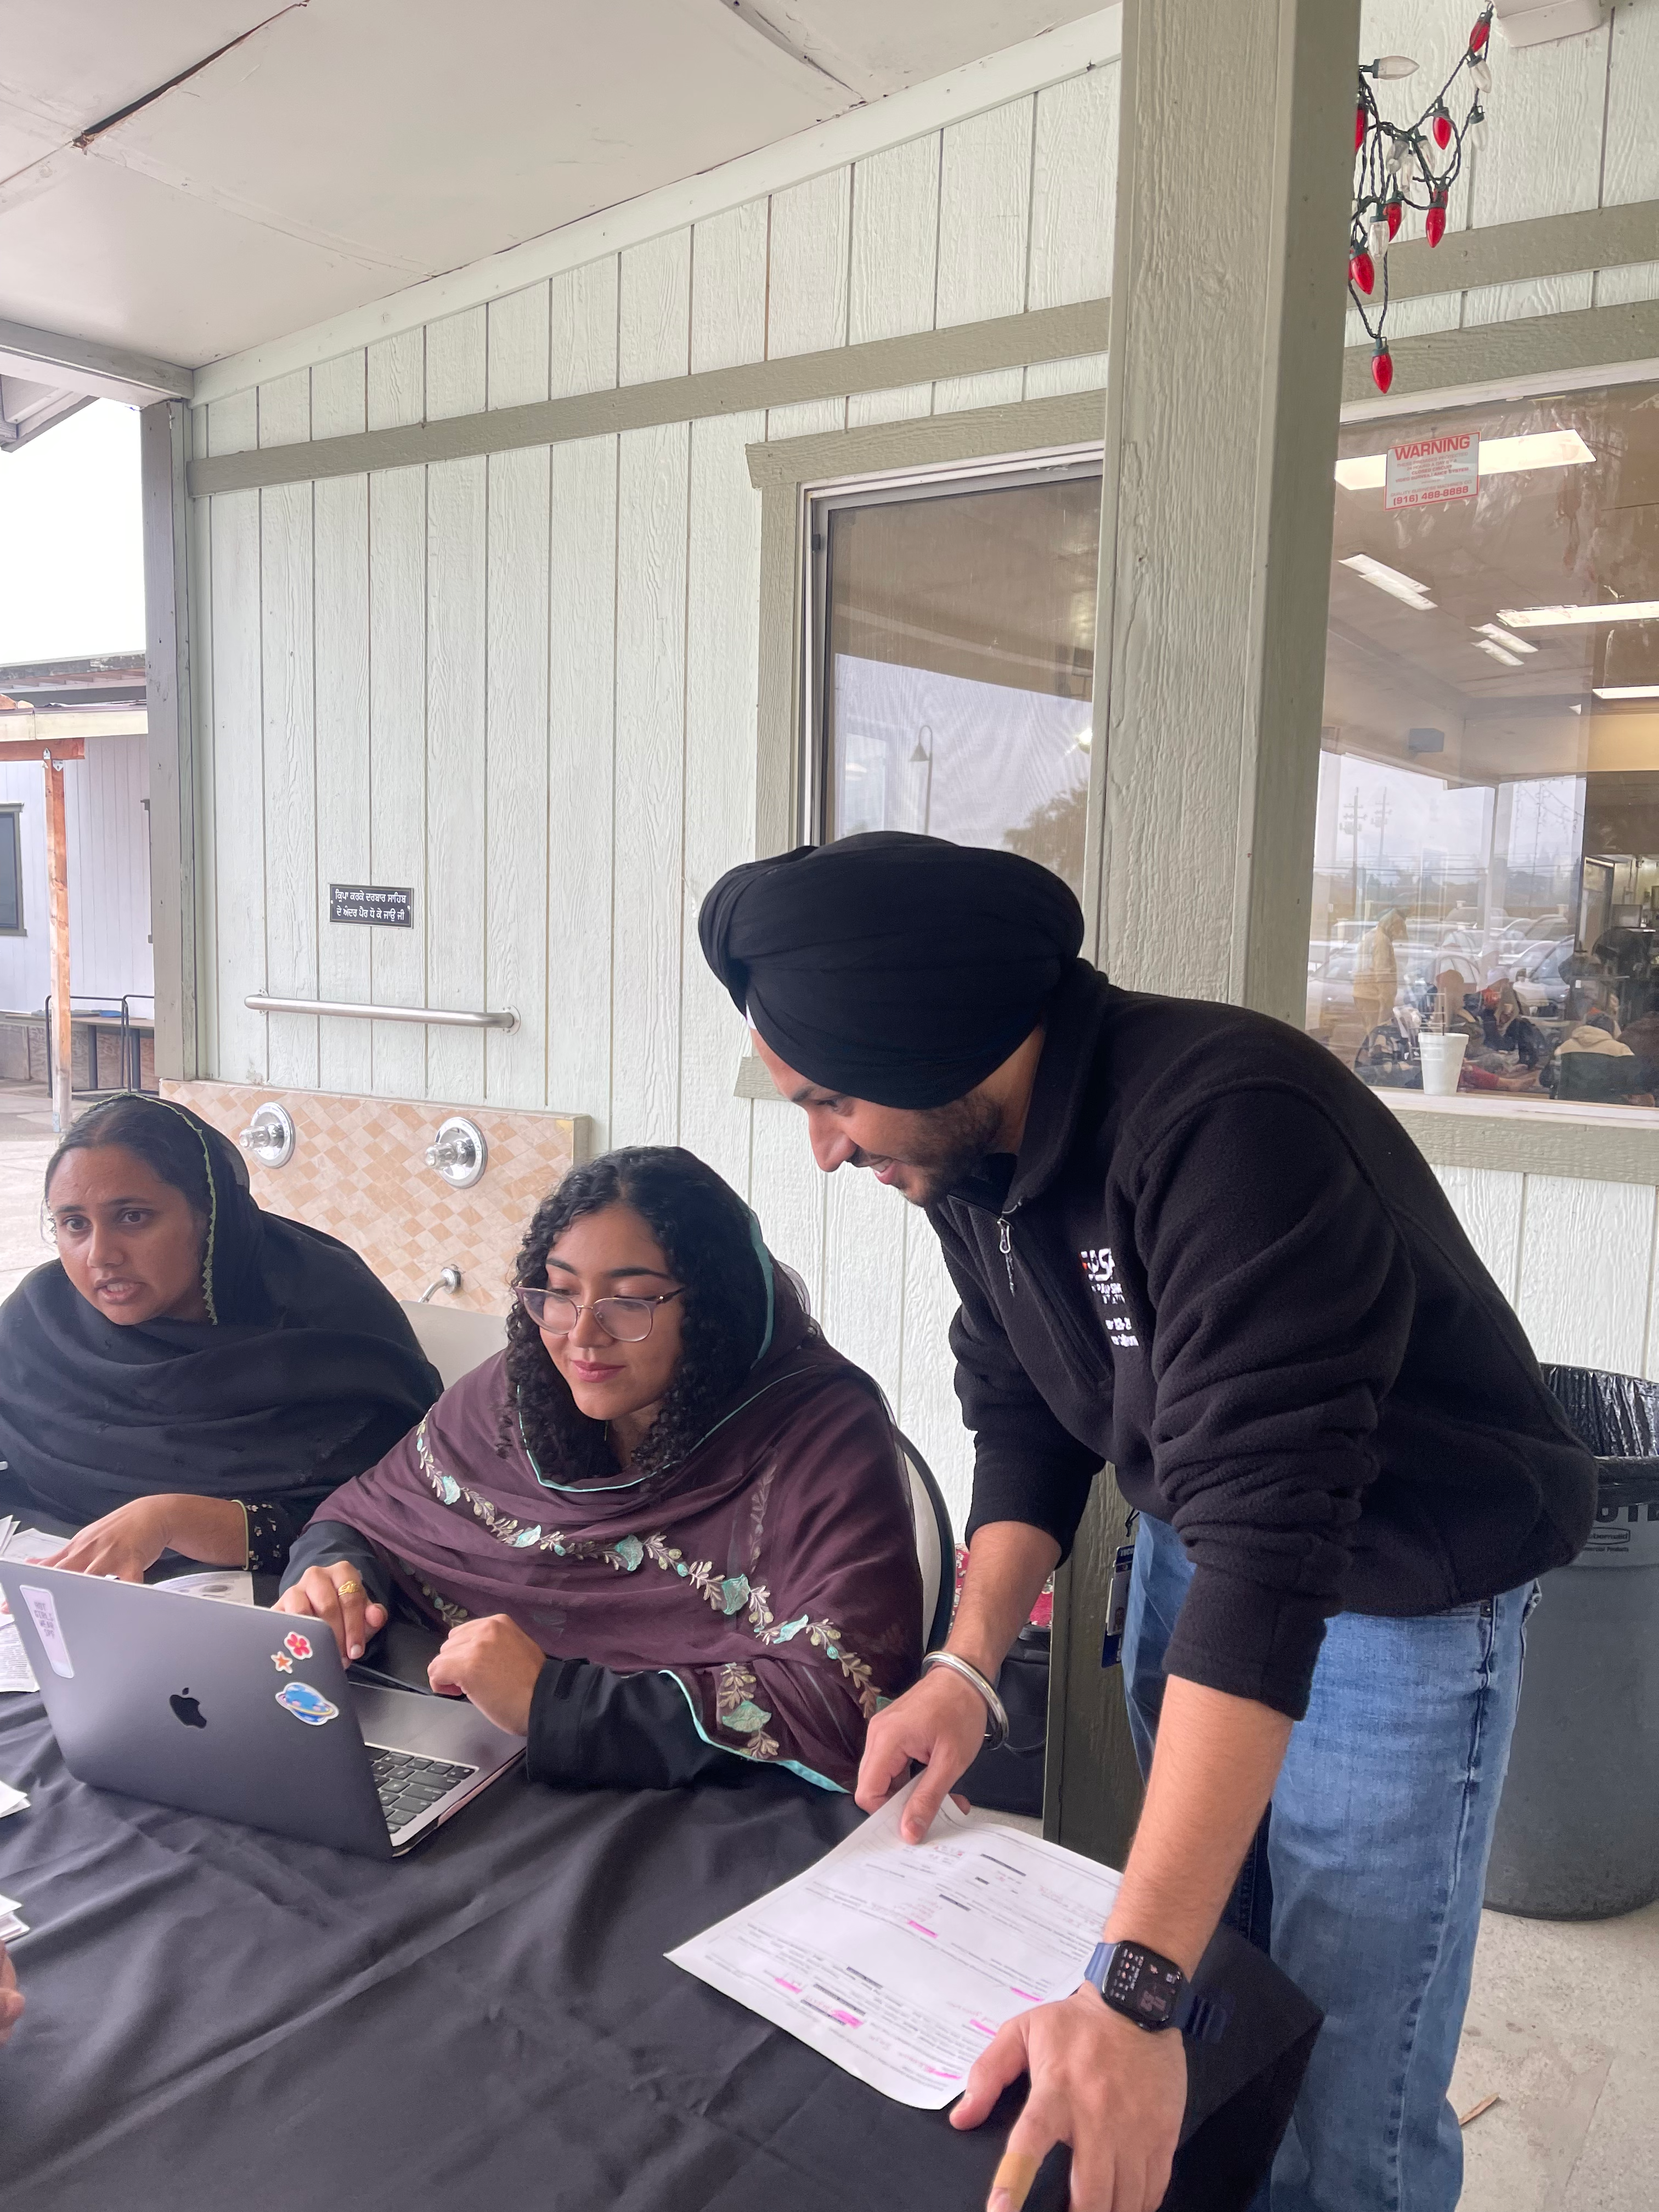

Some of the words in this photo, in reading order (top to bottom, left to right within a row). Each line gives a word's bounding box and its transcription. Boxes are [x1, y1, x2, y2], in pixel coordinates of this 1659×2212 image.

[1395, 436, 1470, 460] WARNING
[1438, 452, 1468, 460] PROTECTED
[1393, 494, 1418, 506] (916)
[1421, 486, 1469, 499] 488-8888
[349, 890, 365, 901] ਕਰਕੇ
[365, 893, 386, 902] ਦਰਬਾਰ
[387, 891, 407, 904] ਸਾਹਿਬ
[336, 905, 342, 916] ਦੇ
[376, 906, 382, 919] ਕੇ
[397, 909, 405, 921] ਜੀ
